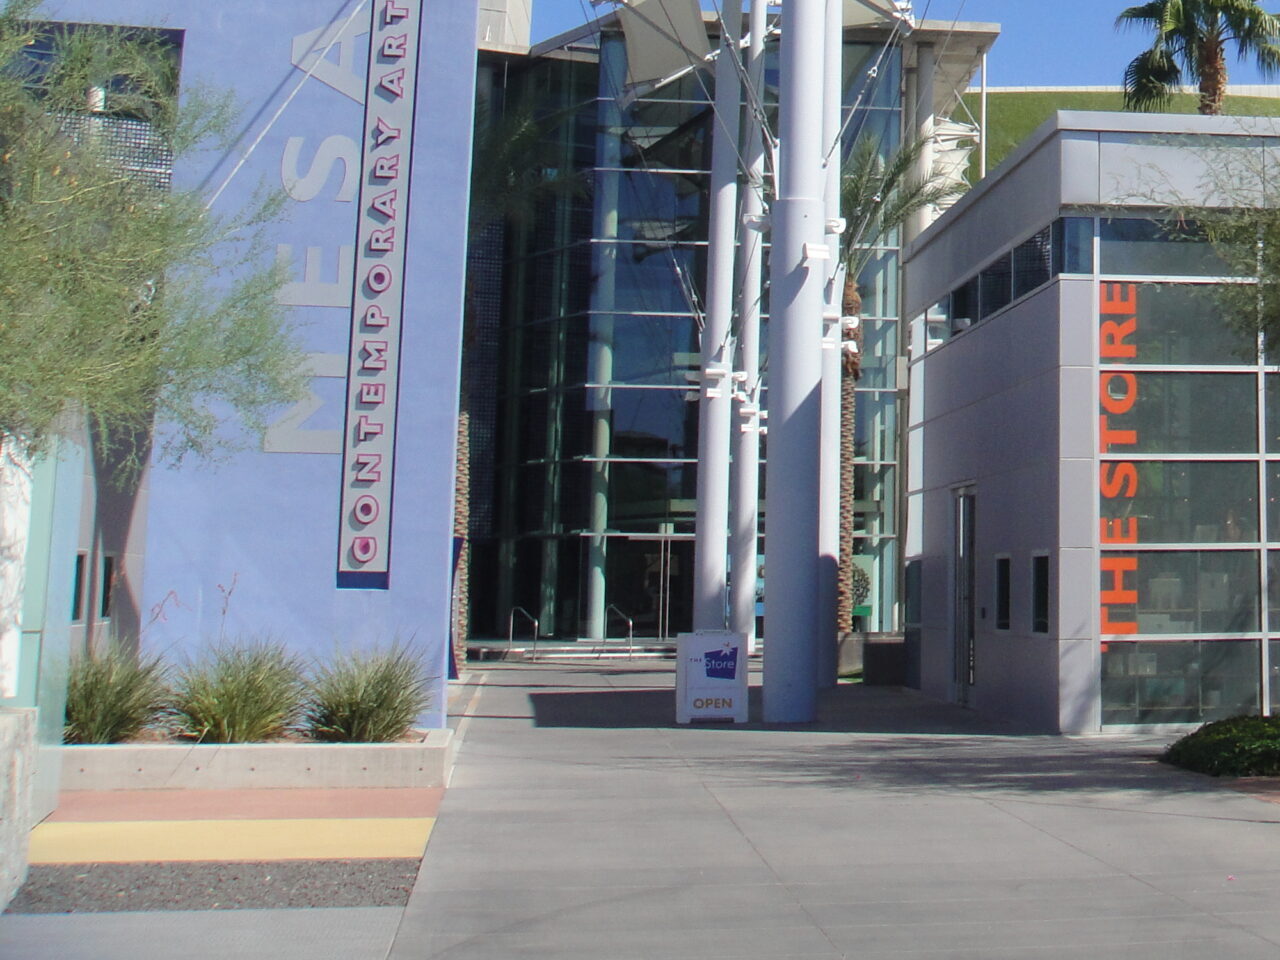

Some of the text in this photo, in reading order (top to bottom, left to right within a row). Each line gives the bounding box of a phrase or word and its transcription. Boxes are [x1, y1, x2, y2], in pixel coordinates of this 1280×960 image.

[264, 8, 371, 454] MESA
[349, 117, 402, 563] CONTEMPORARY
[1099, 282, 1138, 653] THE STORE
[693, 698, 732, 709] OPEN
[705, 658, 735, 669] Store
